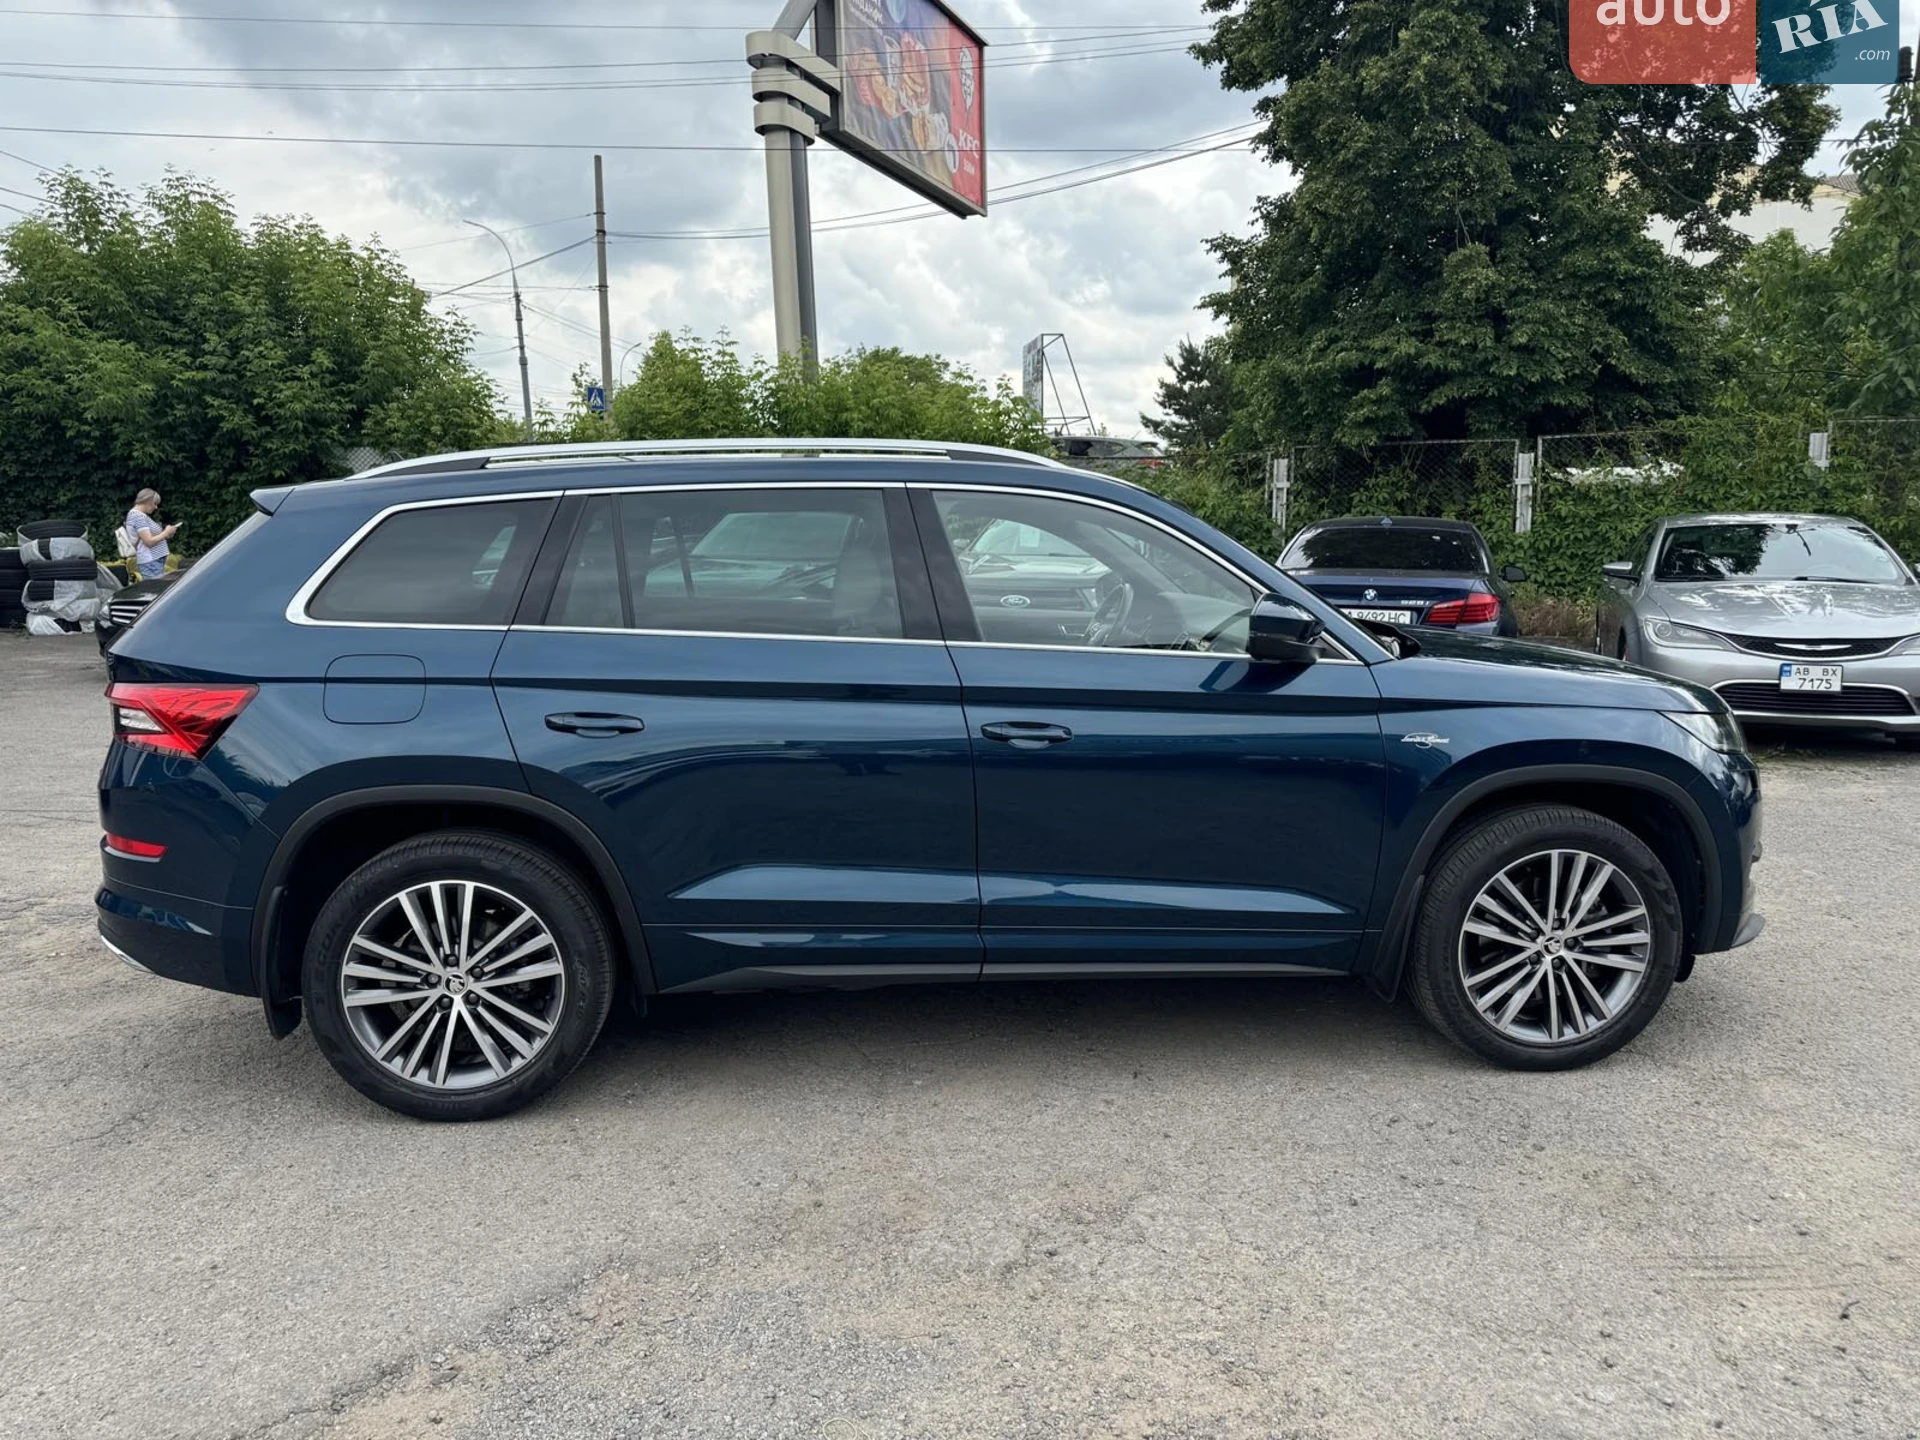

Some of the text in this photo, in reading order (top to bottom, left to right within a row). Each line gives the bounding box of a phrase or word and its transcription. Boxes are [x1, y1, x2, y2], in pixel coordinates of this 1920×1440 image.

[958, 128, 980, 159] KFC
[1794, 667, 1838, 677] AB BX
[1798, 677, 1833, 690] 7175
